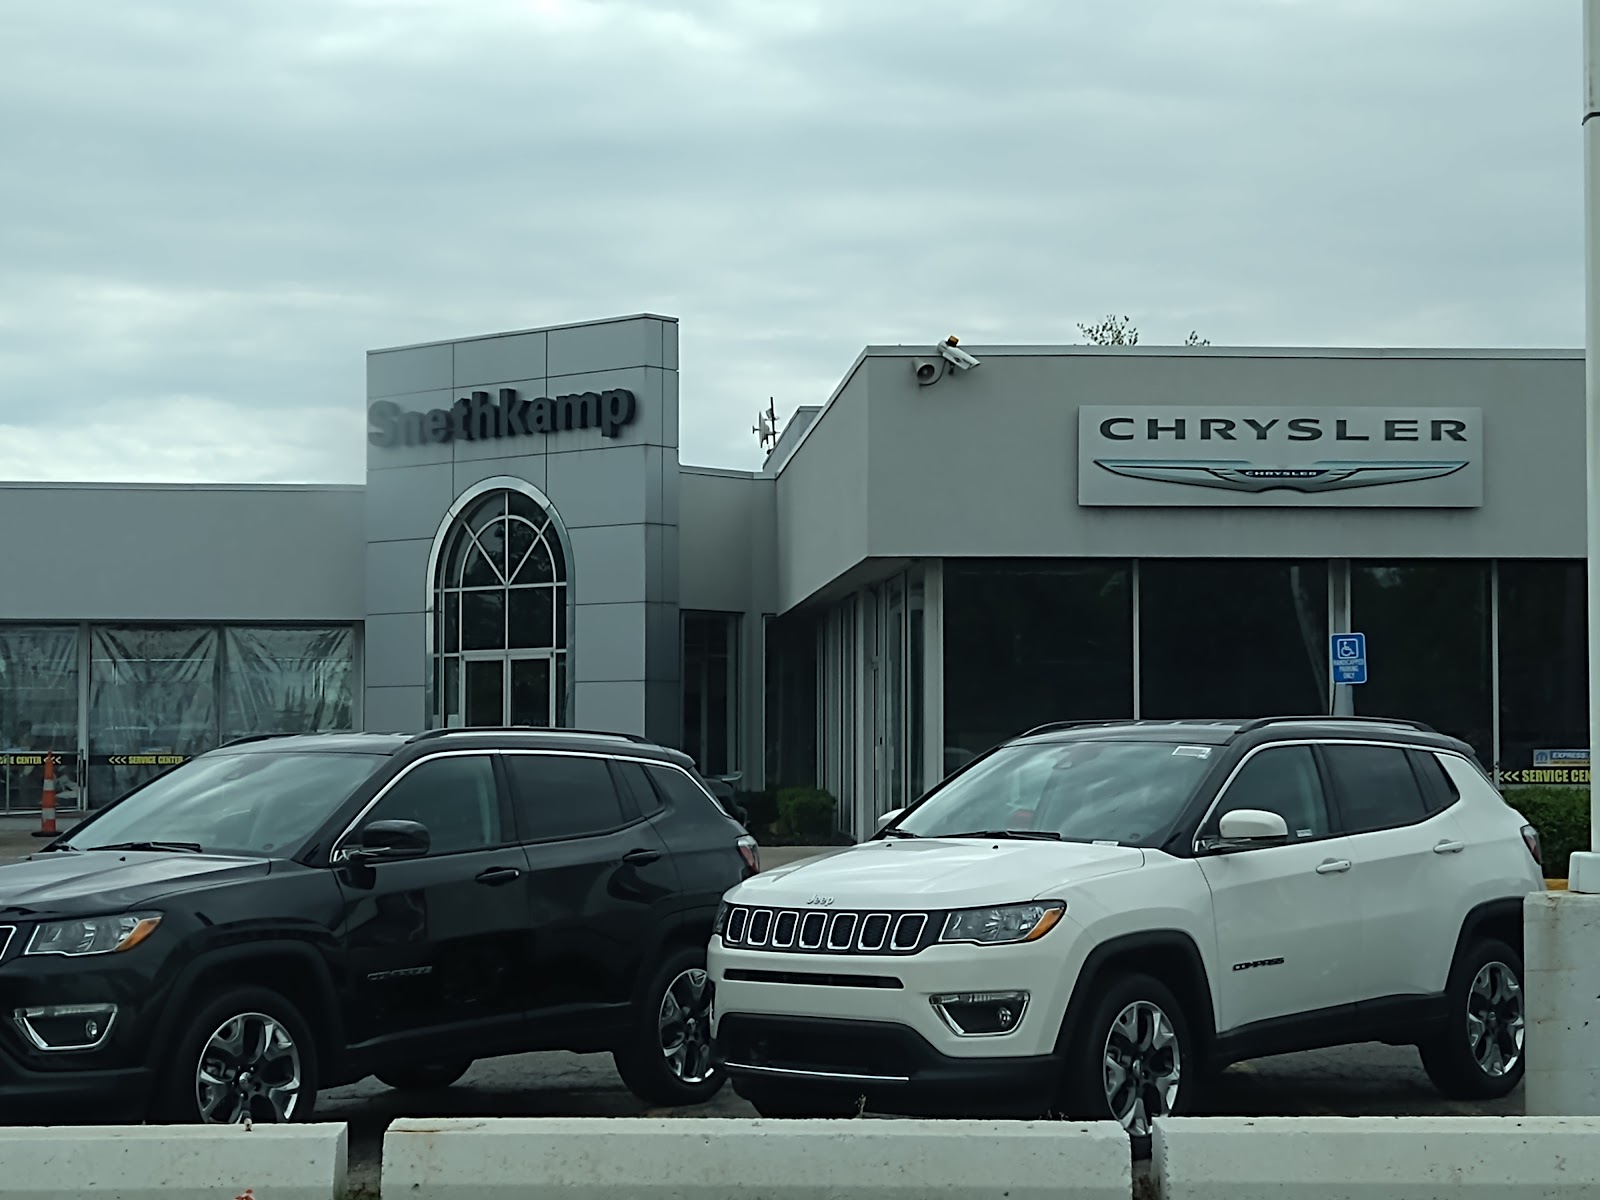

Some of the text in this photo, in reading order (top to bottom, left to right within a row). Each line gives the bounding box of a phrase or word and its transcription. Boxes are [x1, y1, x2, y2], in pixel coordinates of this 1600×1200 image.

[367, 388, 636, 447] Snethkamp
[1099, 417, 1469, 442] CHRYSLER
[16, 756, 42, 765] CENTER
[1521, 769, 1569, 783] SERVICE
[806, 894, 835, 907] Jeep
[1232, 957, 1285, 971] COMPASS
